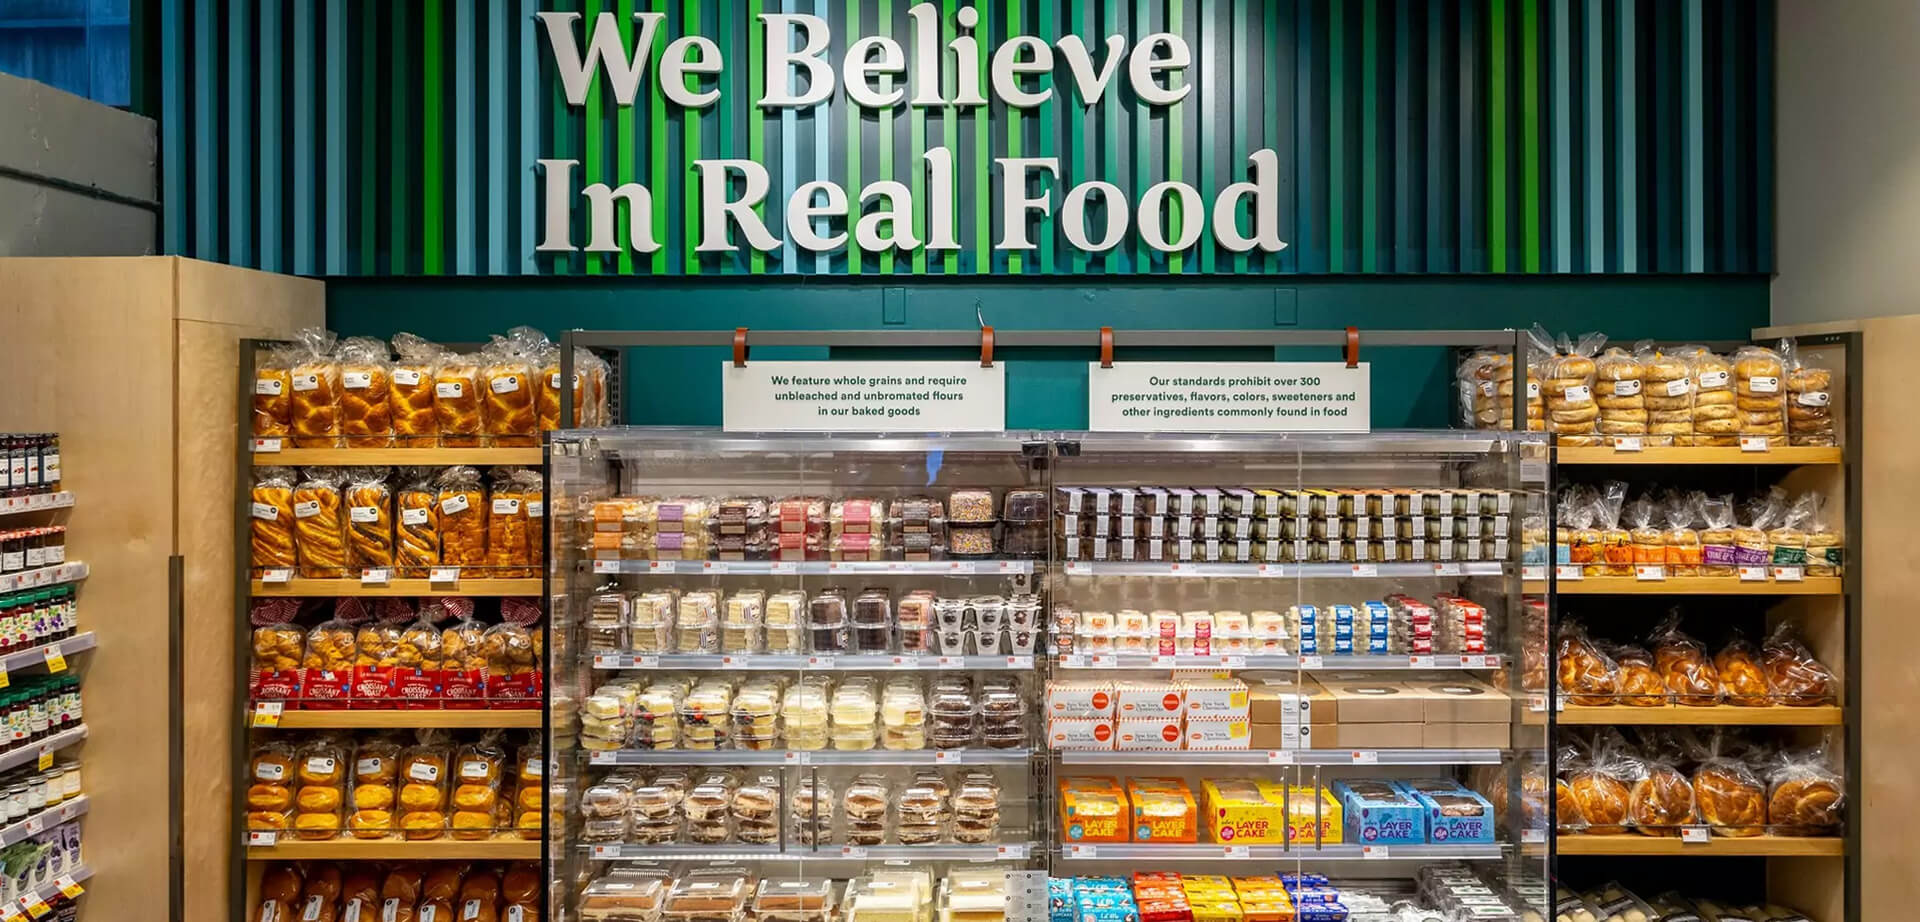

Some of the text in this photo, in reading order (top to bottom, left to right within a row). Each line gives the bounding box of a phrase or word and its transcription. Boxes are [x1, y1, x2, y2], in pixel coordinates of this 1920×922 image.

[538, 3, 1194, 107] We Believe
[536, 148, 1287, 252] In Real Food
[771, 375, 967, 389] We feature whole grains and require
[1148, 376, 1321, 390] Our standards prohibit over 300
[774, 390, 964, 401] unbleached and unbromated flours
[1111, 391, 1356, 404] preservatives, flavors, colors, sweeteners and
[817, 405, 921, 419] in our baked goods
[1122, 406, 1348, 420] other ingredients commonly found in food
[1085, 820, 1118, 828] LAYER
[1152, 820, 1185, 829] LAYER
[1236, 821, 1268, 829] LAYER
[1379, 822, 1412, 830] LAYER
[1450, 822, 1482, 830] LAYER
[1085, 829, 1114, 837] CAKE
[1152, 829, 1182, 838] CAKE
[1236, 829, 1264, 838] CAKE
[1379, 830, 1409, 839] CAKE
[1450, 830, 1479, 839] CAKE
